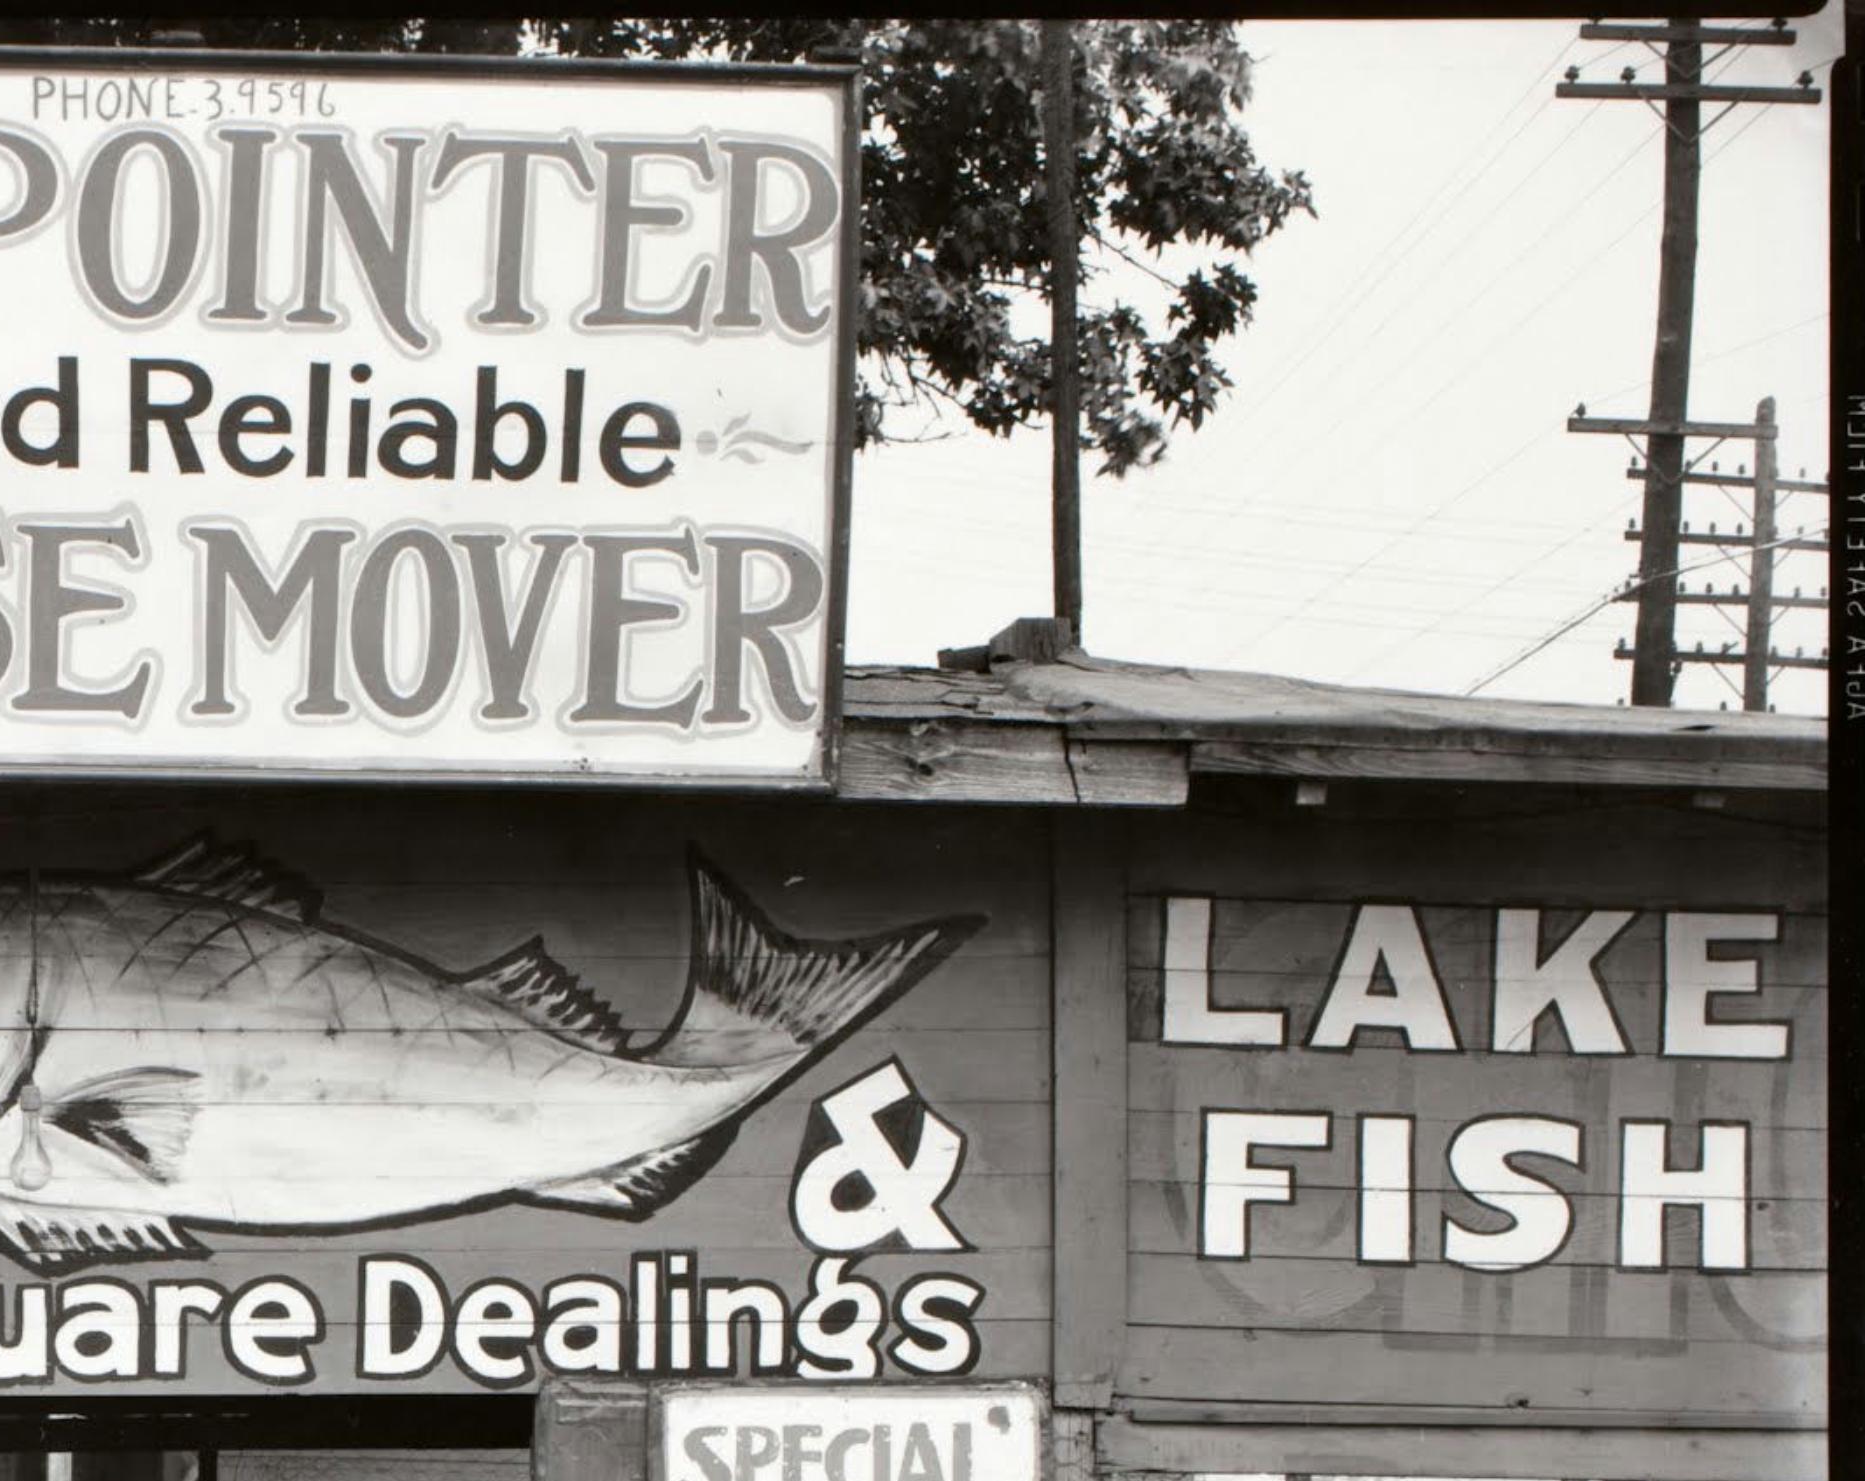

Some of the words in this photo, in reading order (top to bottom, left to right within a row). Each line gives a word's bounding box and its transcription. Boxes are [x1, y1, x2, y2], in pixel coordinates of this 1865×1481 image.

[129, 360, 683, 489] Reliable
[182, 519, 827, 737] MOVER
[1159, 892, 1794, 1060] LAKE
[1198, 1108, 1752, 1274] FISH
[357, 1247, 983, 1382] Dealings
